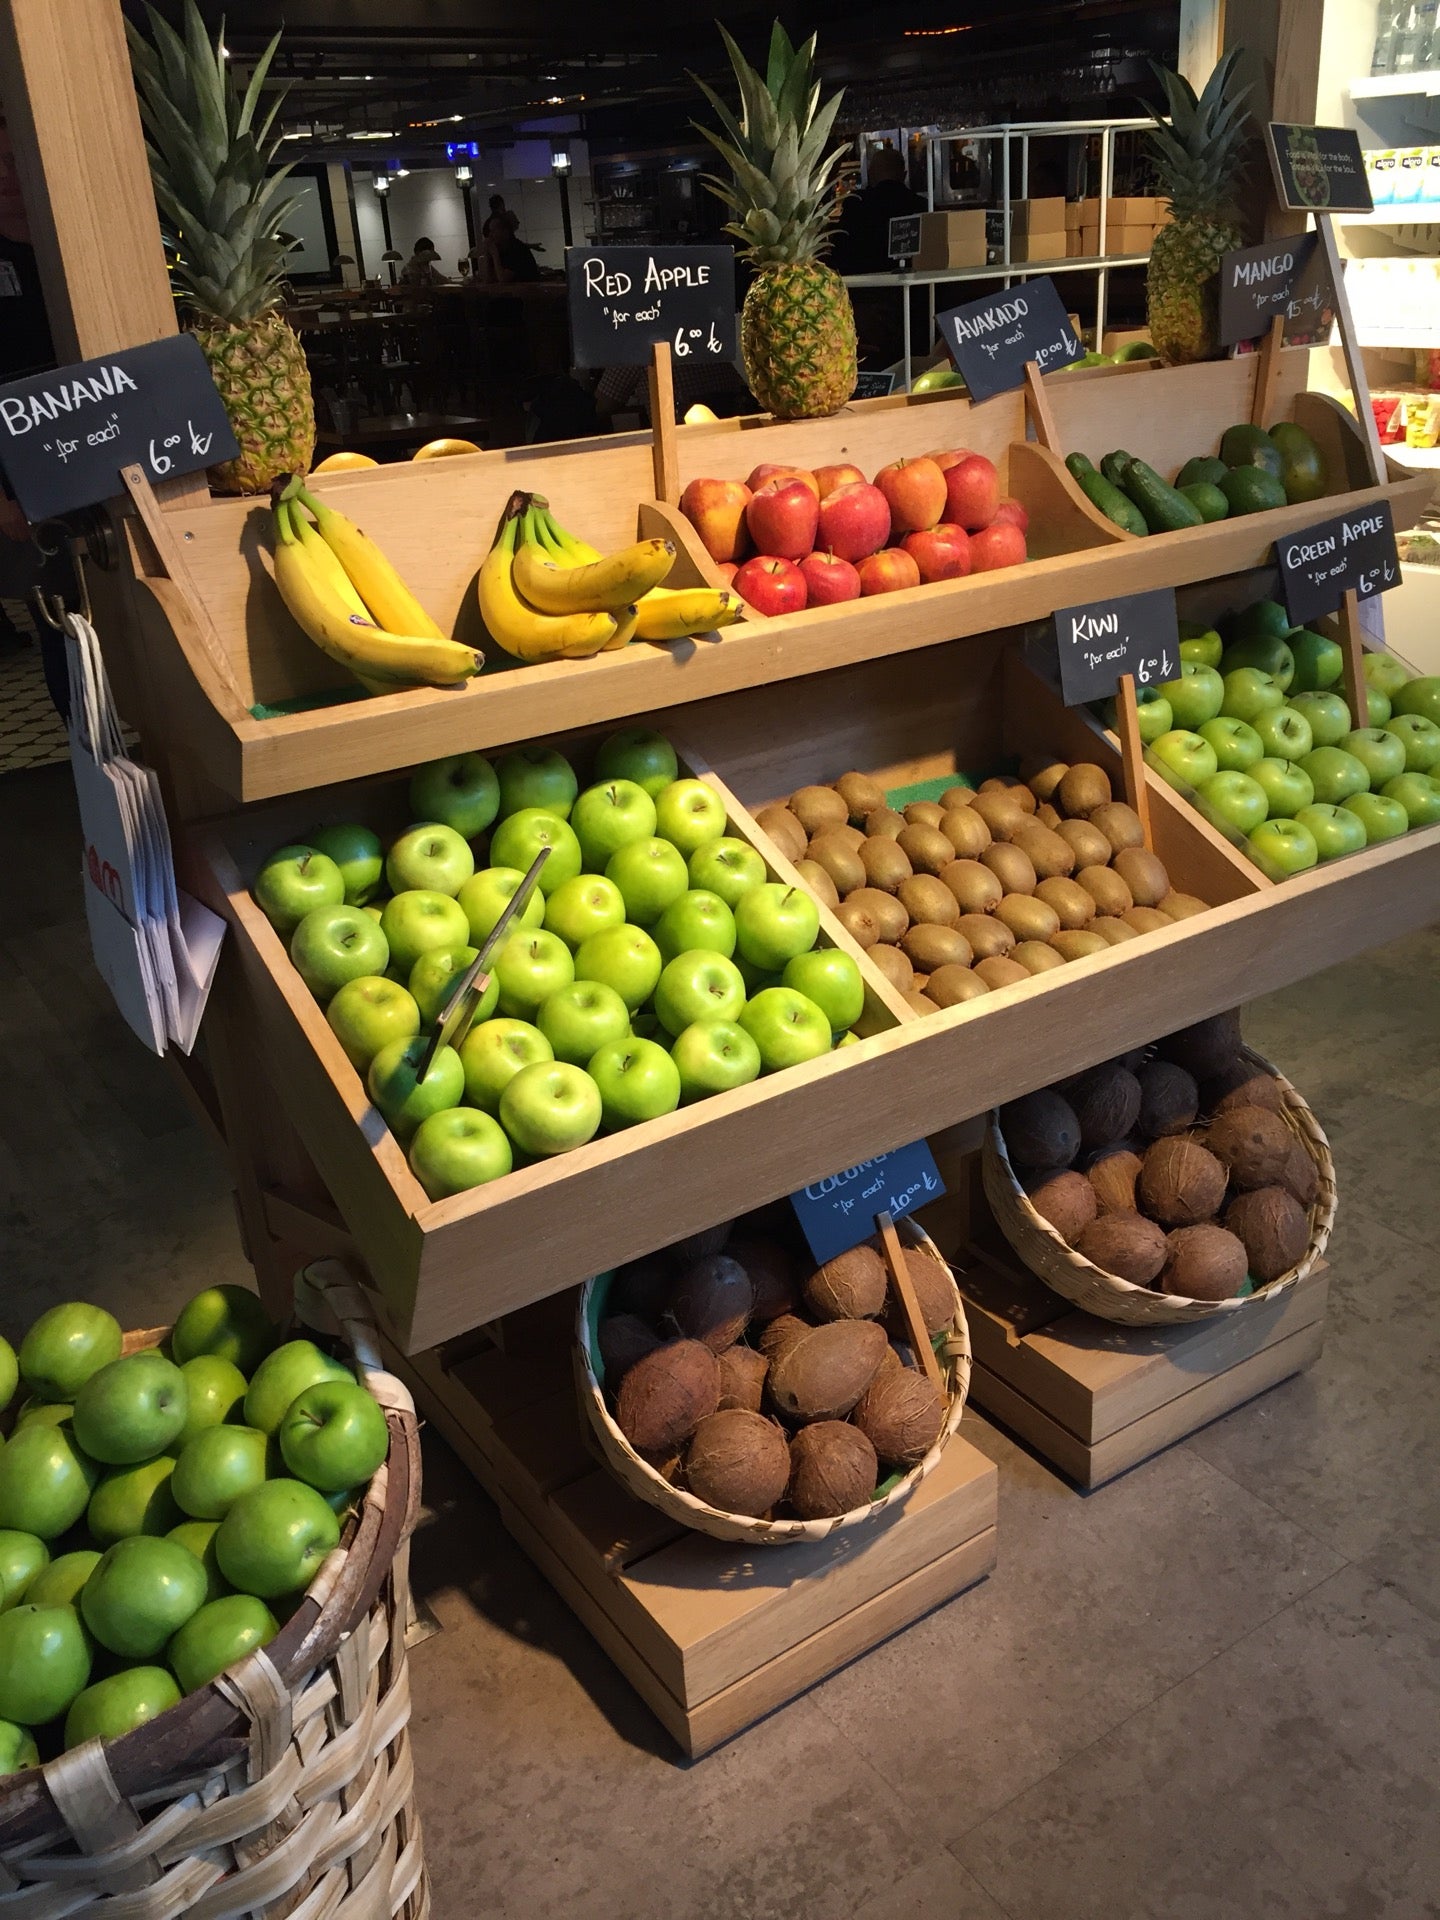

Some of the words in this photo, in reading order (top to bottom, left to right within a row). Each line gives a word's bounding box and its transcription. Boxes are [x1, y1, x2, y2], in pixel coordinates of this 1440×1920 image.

[1376, 159, 1395, 168] alpro
[1403, 157, 1422, 166] alpro
[584, 258, 632, 297] RED
[644, 257, 710, 294] APPLE
[1233, 253, 1294, 288] MANGO
[954, 298, 1029, 344] AVAKADO
[0, 366, 138, 436] BANANA
[1286, 536, 1336, 569] GREEN
[1342, 516, 1384, 547] APPLE
[1071, 613, 1119, 644] KIWI
